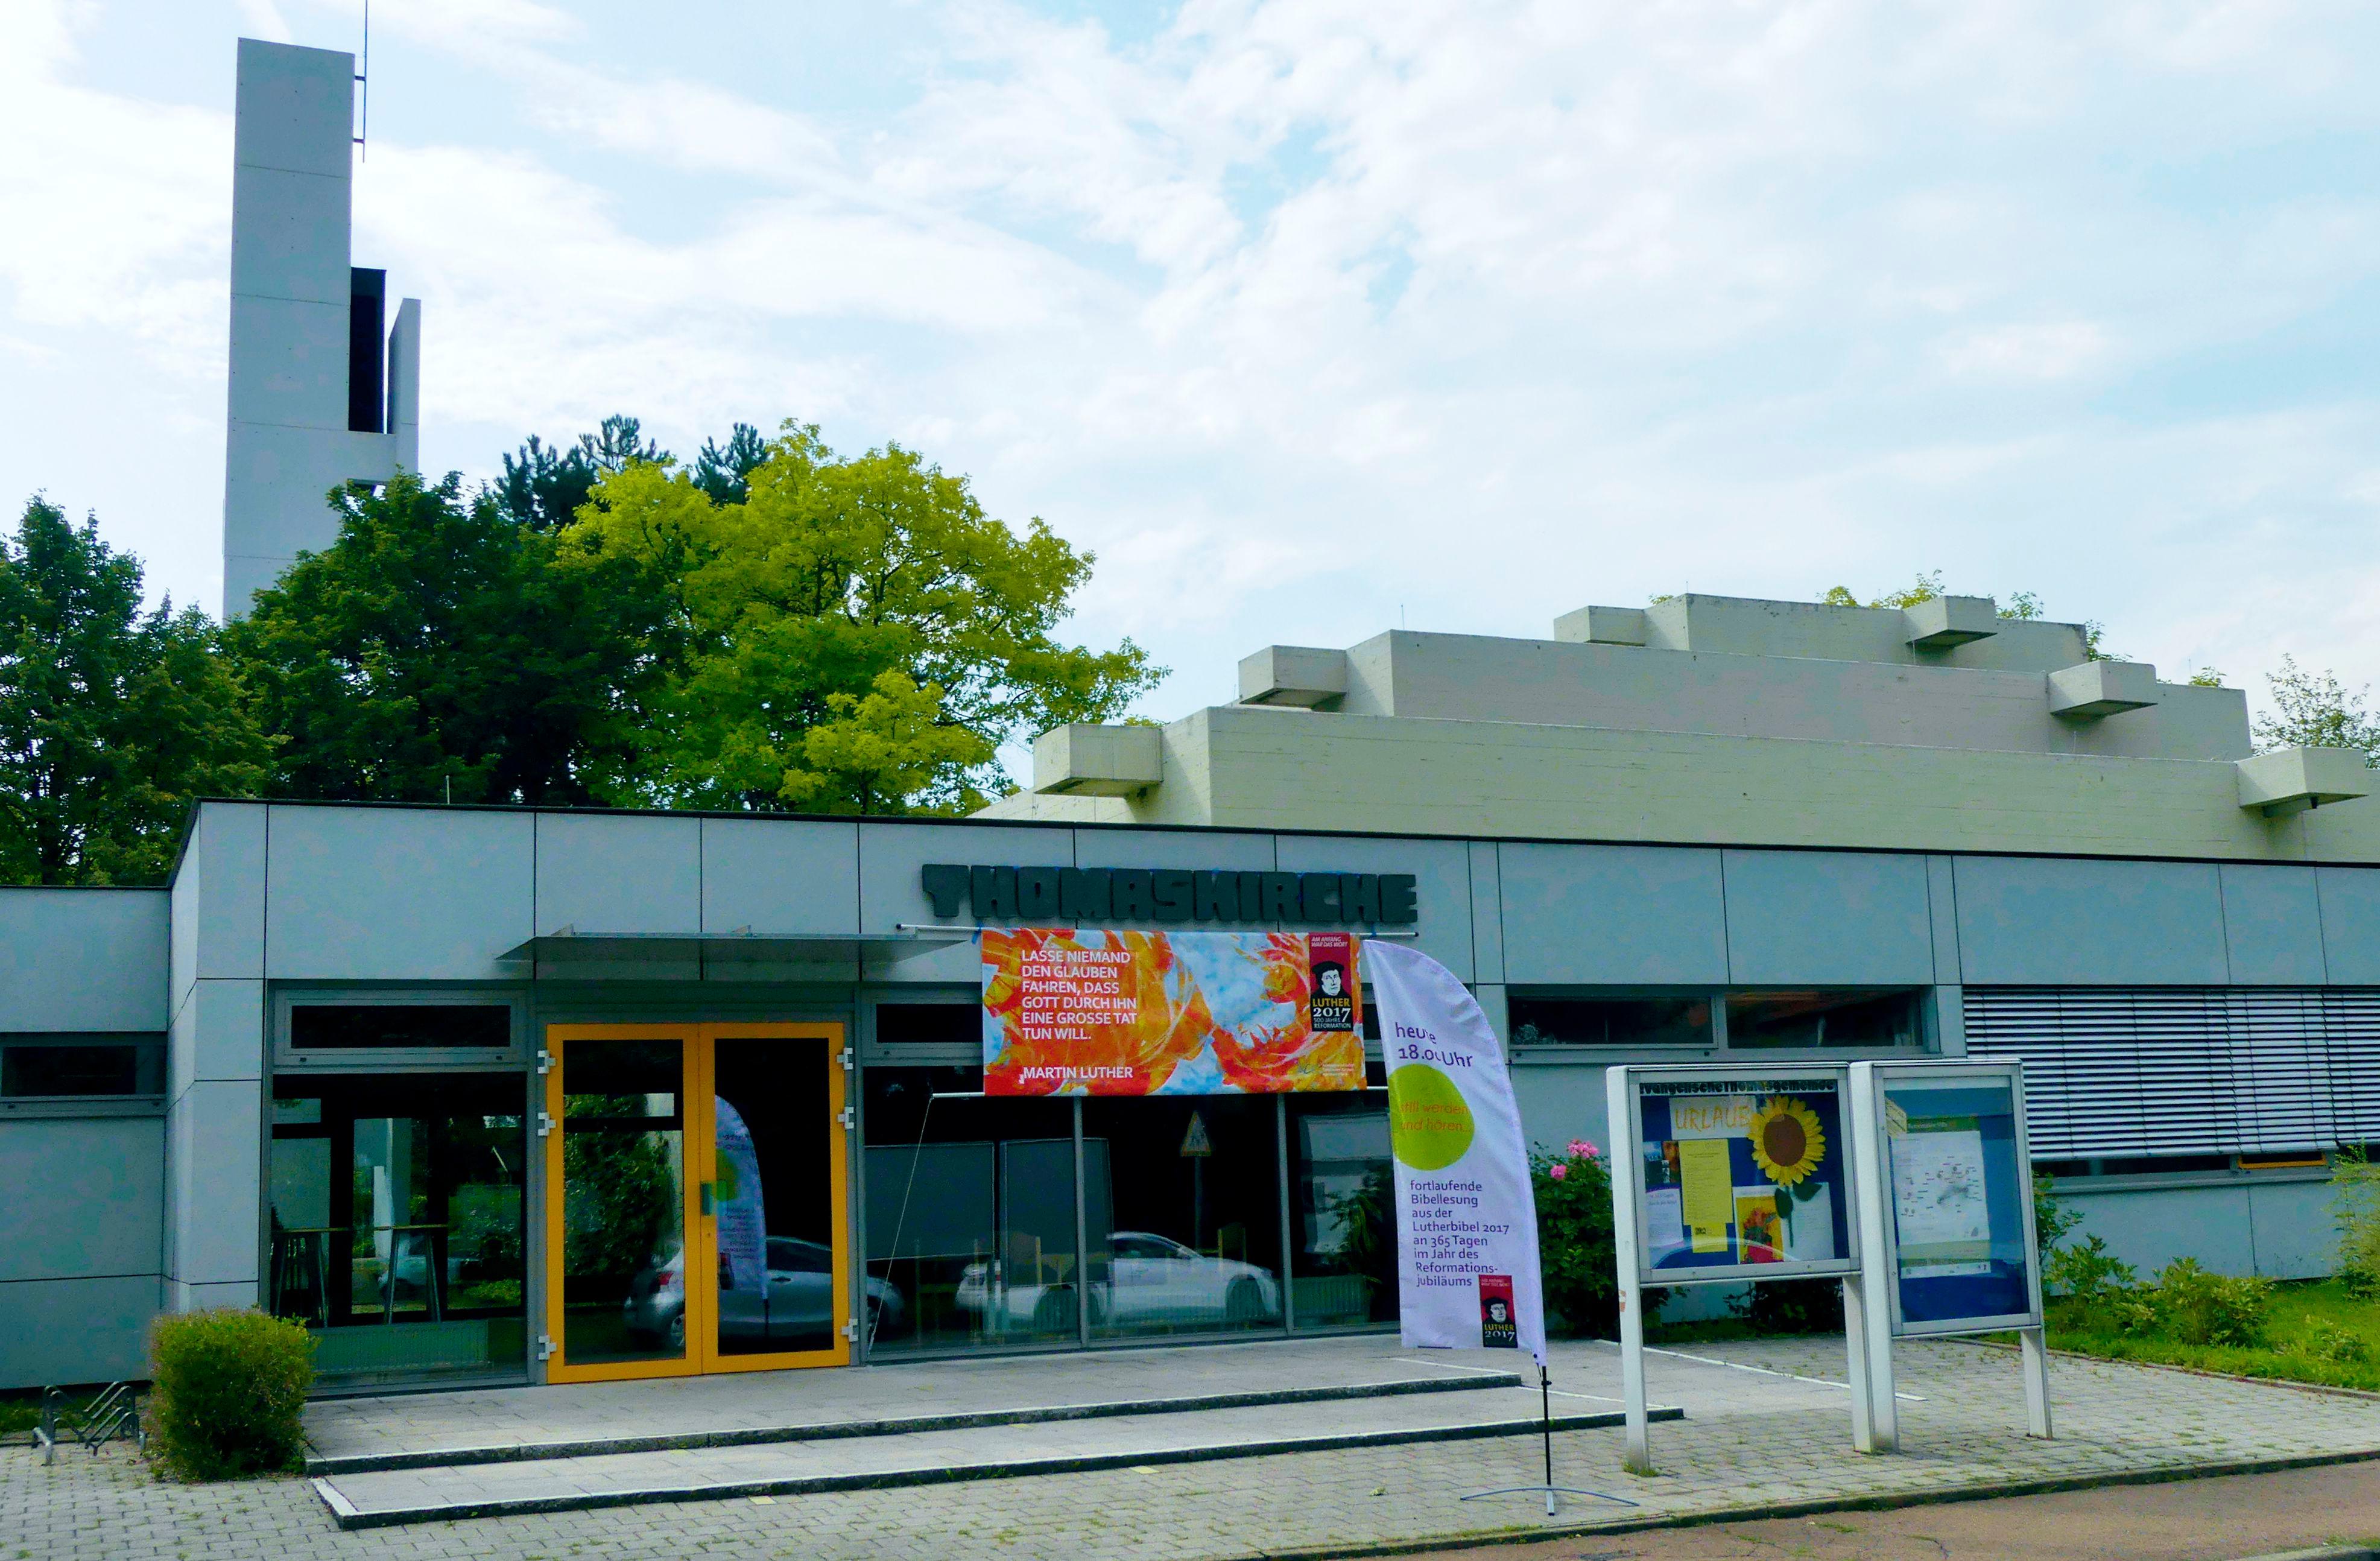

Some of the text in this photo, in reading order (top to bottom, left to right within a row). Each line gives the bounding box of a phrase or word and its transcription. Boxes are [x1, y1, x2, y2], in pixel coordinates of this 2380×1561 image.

[922, 864, 1418, 923] THOMASKIRCHE
[1022, 950, 1130, 963] LASSE NIEMAND
[1022, 965, 1117, 978] DEN GLAUBEN
[1022, 981, 1119, 996] FAHREN, DASS
[1022, 996, 1136, 1009] GOTT DURCH IHN
[1313, 998, 1350, 1007] LUTHER
[1022, 1012, 1137, 1024] EINE GROSSE TAT
[1313, 1007, 1351, 1022] 2017
[1022, 1028, 1092, 1040] TUN WILL.
[1442, 1051, 1473, 1067] Uhr
[1023, 1067, 1133, 1078] MARTIN LUTHER
[1423, 1103, 1467, 1114] werden
[1400, 1119, 1423, 1130] und
[1675, 1105, 1750, 1132] URLAUB
[1411, 1180, 1482, 1191] fortlaufende
[1411, 1194, 1478, 1207] Bibellesung
[1435, 1208, 1452, 1217] der
[1413, 1221, 1509, 1235] Lutherbibel 2017
[1431, 1235, 1450, 1248] 365
[1452, 1235, 1487, 1248] Tagen
[1414, 1248, 1478, 1259] im Jahr des
[1416, 1262, 1498, 1273] Reformations-
[1417, 1274, 1472, 1287] jubiläums
[1485, 1331, 1514, 1341] 2017
